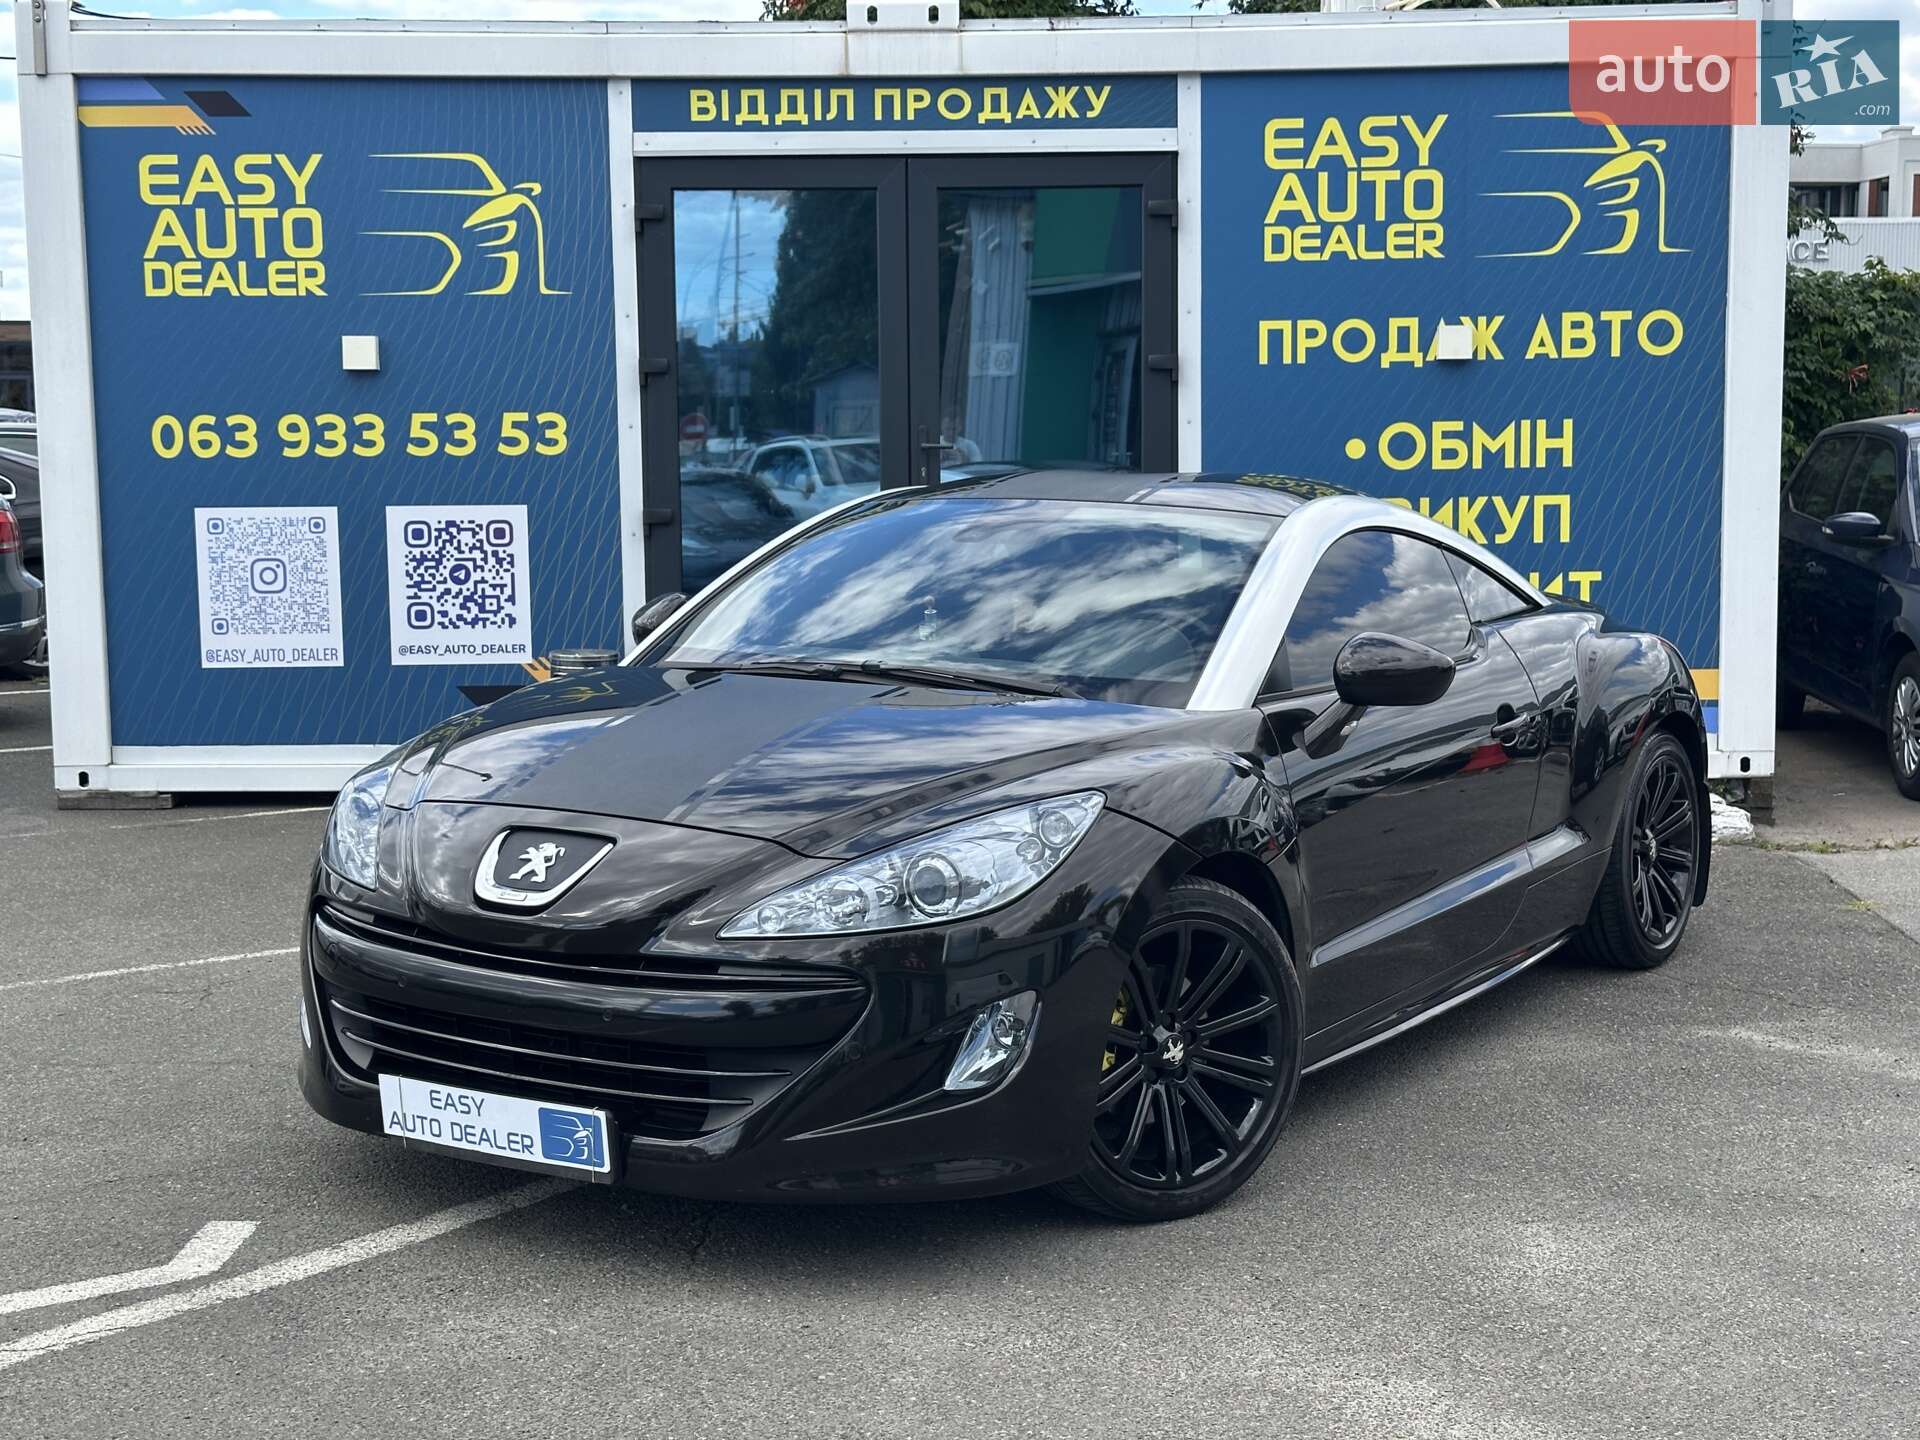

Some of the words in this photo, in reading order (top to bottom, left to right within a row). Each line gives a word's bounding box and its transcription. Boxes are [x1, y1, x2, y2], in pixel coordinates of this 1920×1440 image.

[690, 88, 855, 125] ВІДДІЛ
[874, 86, 1111, 124] ПРОДАЖУ
[1264, 114, 1448, 169] EASY
[138, 154, 322, 205] EASY
[1264, 169, 1444, 223] AUTO
[143, 207, 324, 259] AUTO
[1264, 222, 1445, 262] DEALER
[143, 260, 328, 297] DEALER
[1258, 315, 1504, 369] ПРОДЖ
[1525, 309, 1684, 359] АВТО
[151, 414, 258, 459] 063
[277, 413, 385, 458] 933
[406, 412, 477, 457] 53
[497, 411, 568, 456] 53
[1378, 418, 1573, 471] ОБМІН
[1386, 494, 1571, 545] ИКУП
[205, 647, 338, 664] @EASY_AUTO_DEALER
[399, 643, 527, 656] @EASY_AUTO_DEALER
[429, 1089, 485, 1117] EASY
[389, 1111, 442, 1138] AUTO
[450, 1122, 535, 1155] DEALER
